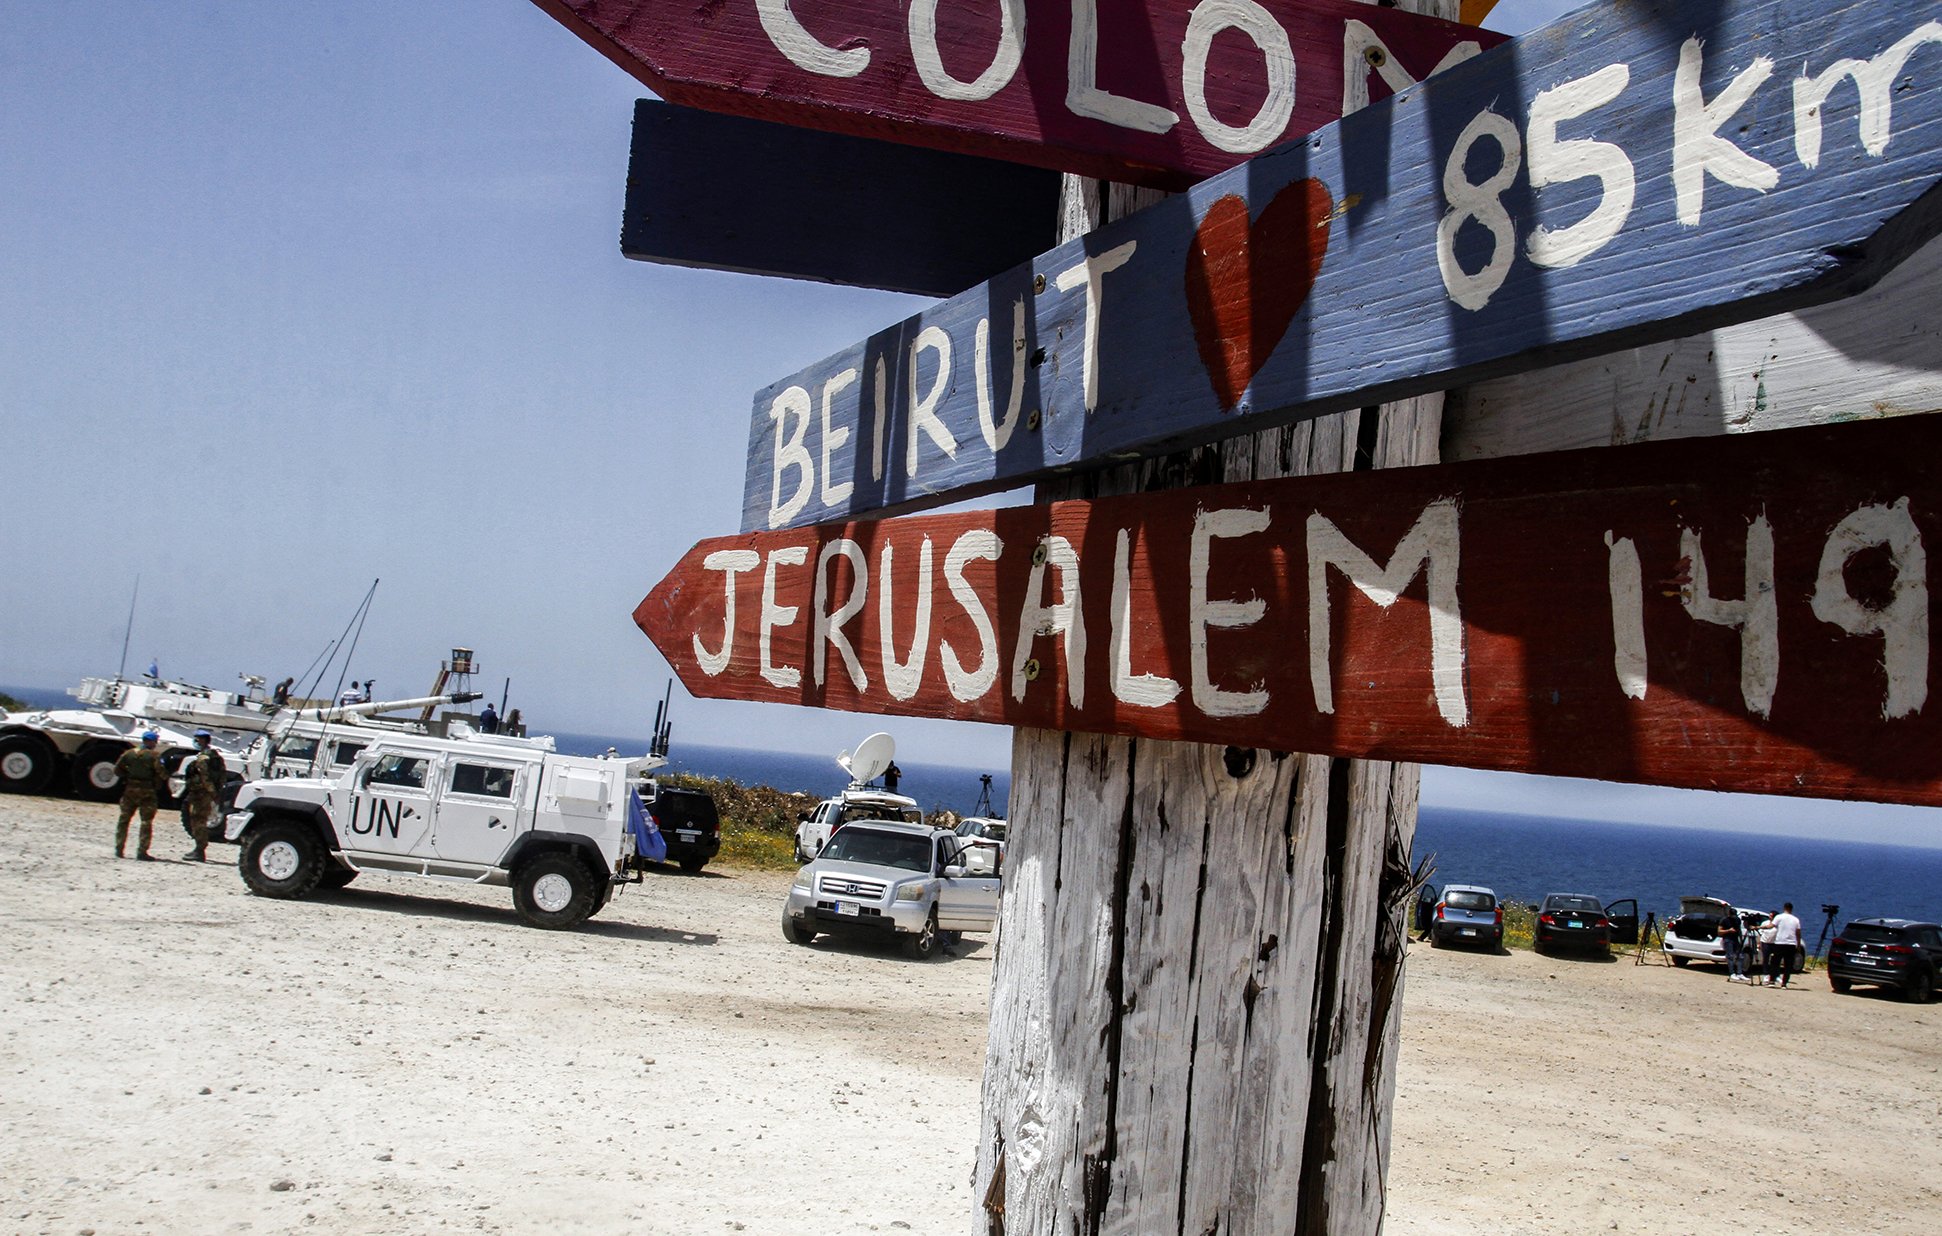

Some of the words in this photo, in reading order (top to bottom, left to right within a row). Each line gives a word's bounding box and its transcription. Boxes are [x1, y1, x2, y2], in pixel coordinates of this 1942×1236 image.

[767, 239, 1137, 531] BEIRUT
[1436, 97, 1636, 313] 85
[692, 492, 1469, 728] JERUSALEM
[1603, 495, 1930, 722] 149
[352, 795, 403, 839] UN
